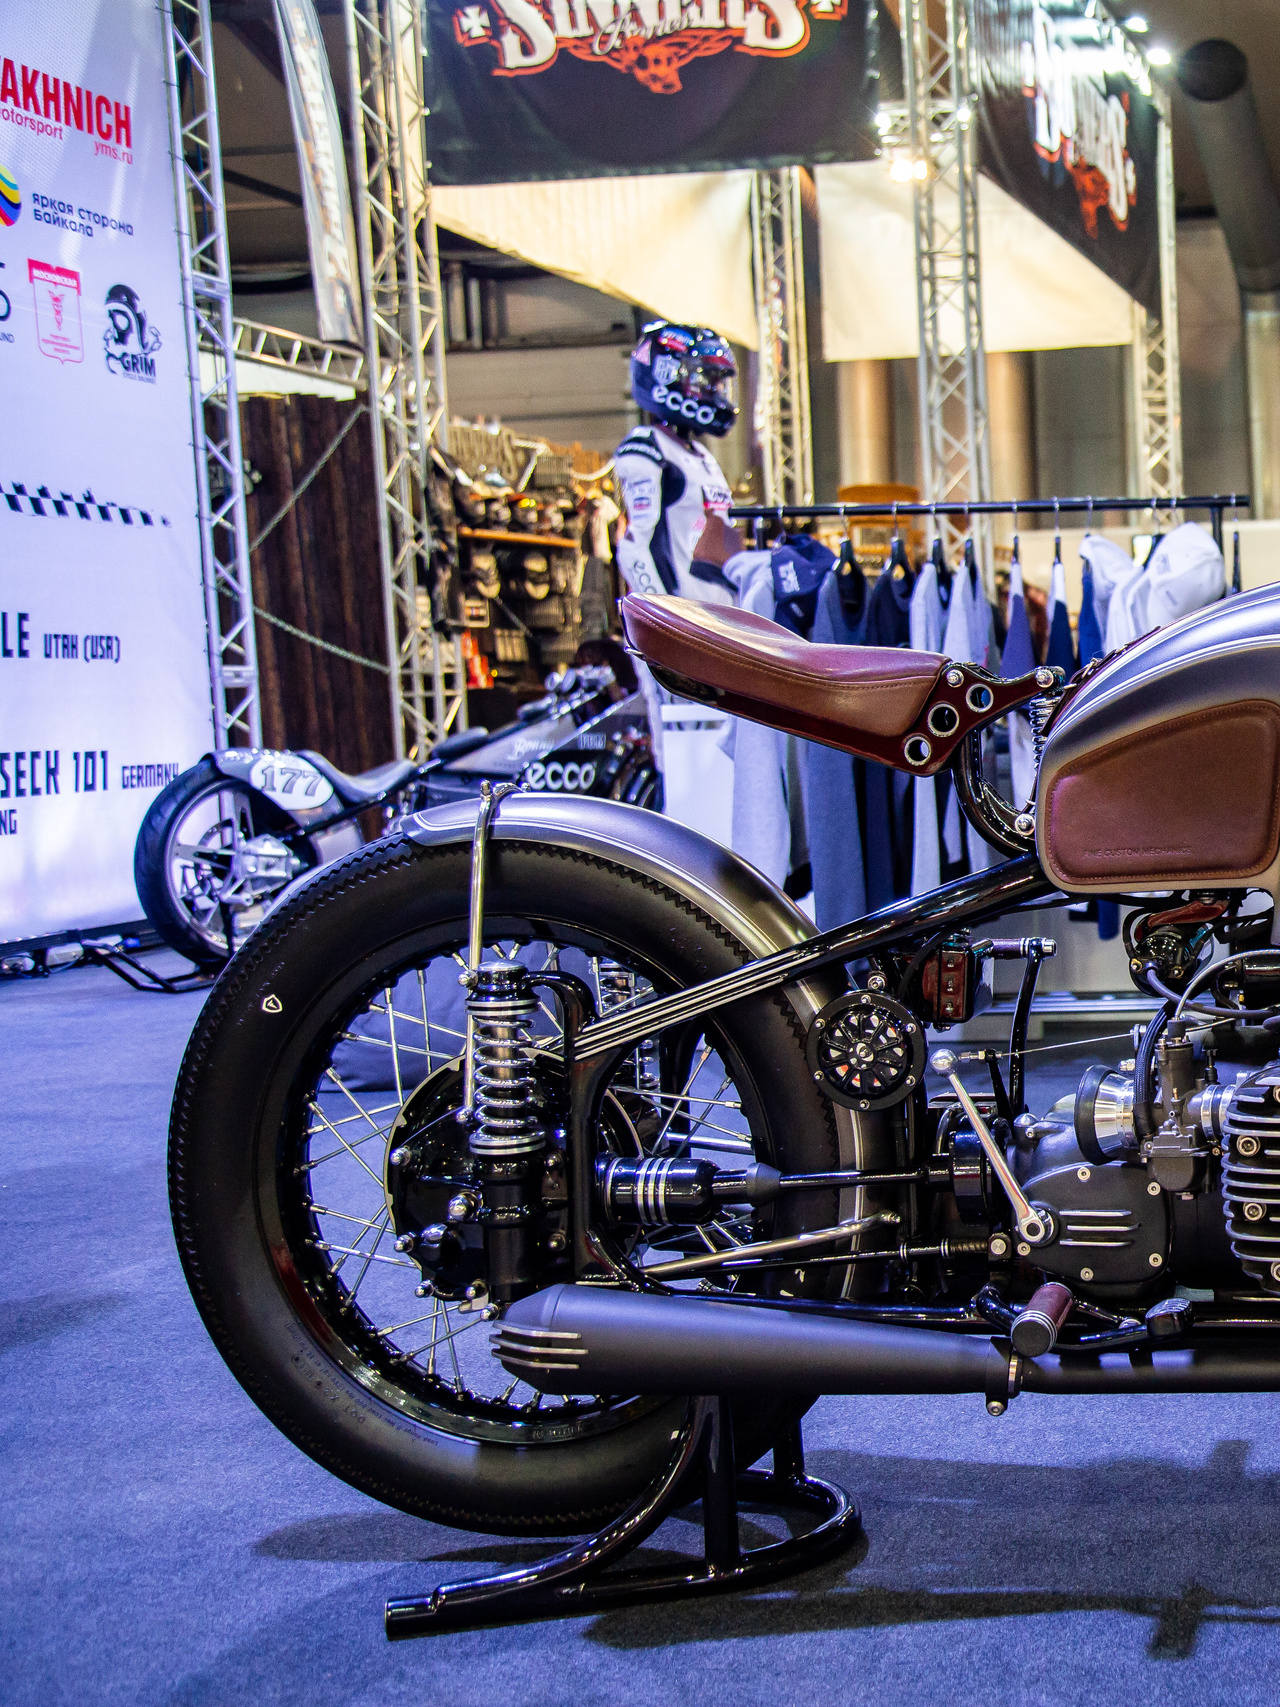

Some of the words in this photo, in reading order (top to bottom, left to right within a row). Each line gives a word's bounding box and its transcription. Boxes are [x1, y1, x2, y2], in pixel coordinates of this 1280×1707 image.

[0, 57, 133, 149] AKHNICH
[0, 108, 63, 140] otorsport
[94, 140, 133, 165] yms.ru
[32, 193, 74, 216] яркая
[78, 207, 134, 236] сторона
[34, 208, 94, 237] Байкала
[120, 352, 157, 378] GRIM
[652, 384, 716, 424] ecco
[1, 612, 30, 659] LE
[44, 633, 79, 659] UTAH
[84, 634, 121, 663] (USA)
[73, 750, 109, 793] 101
[122, 763, 179, 789] GERMANY
[261, 765, 323, 797] 177
[525, 762, 596, 790] ecco
[1104, 848, 1140, 858] CUSTOM
[1142, 846, 1192, 857] MECHANICS
